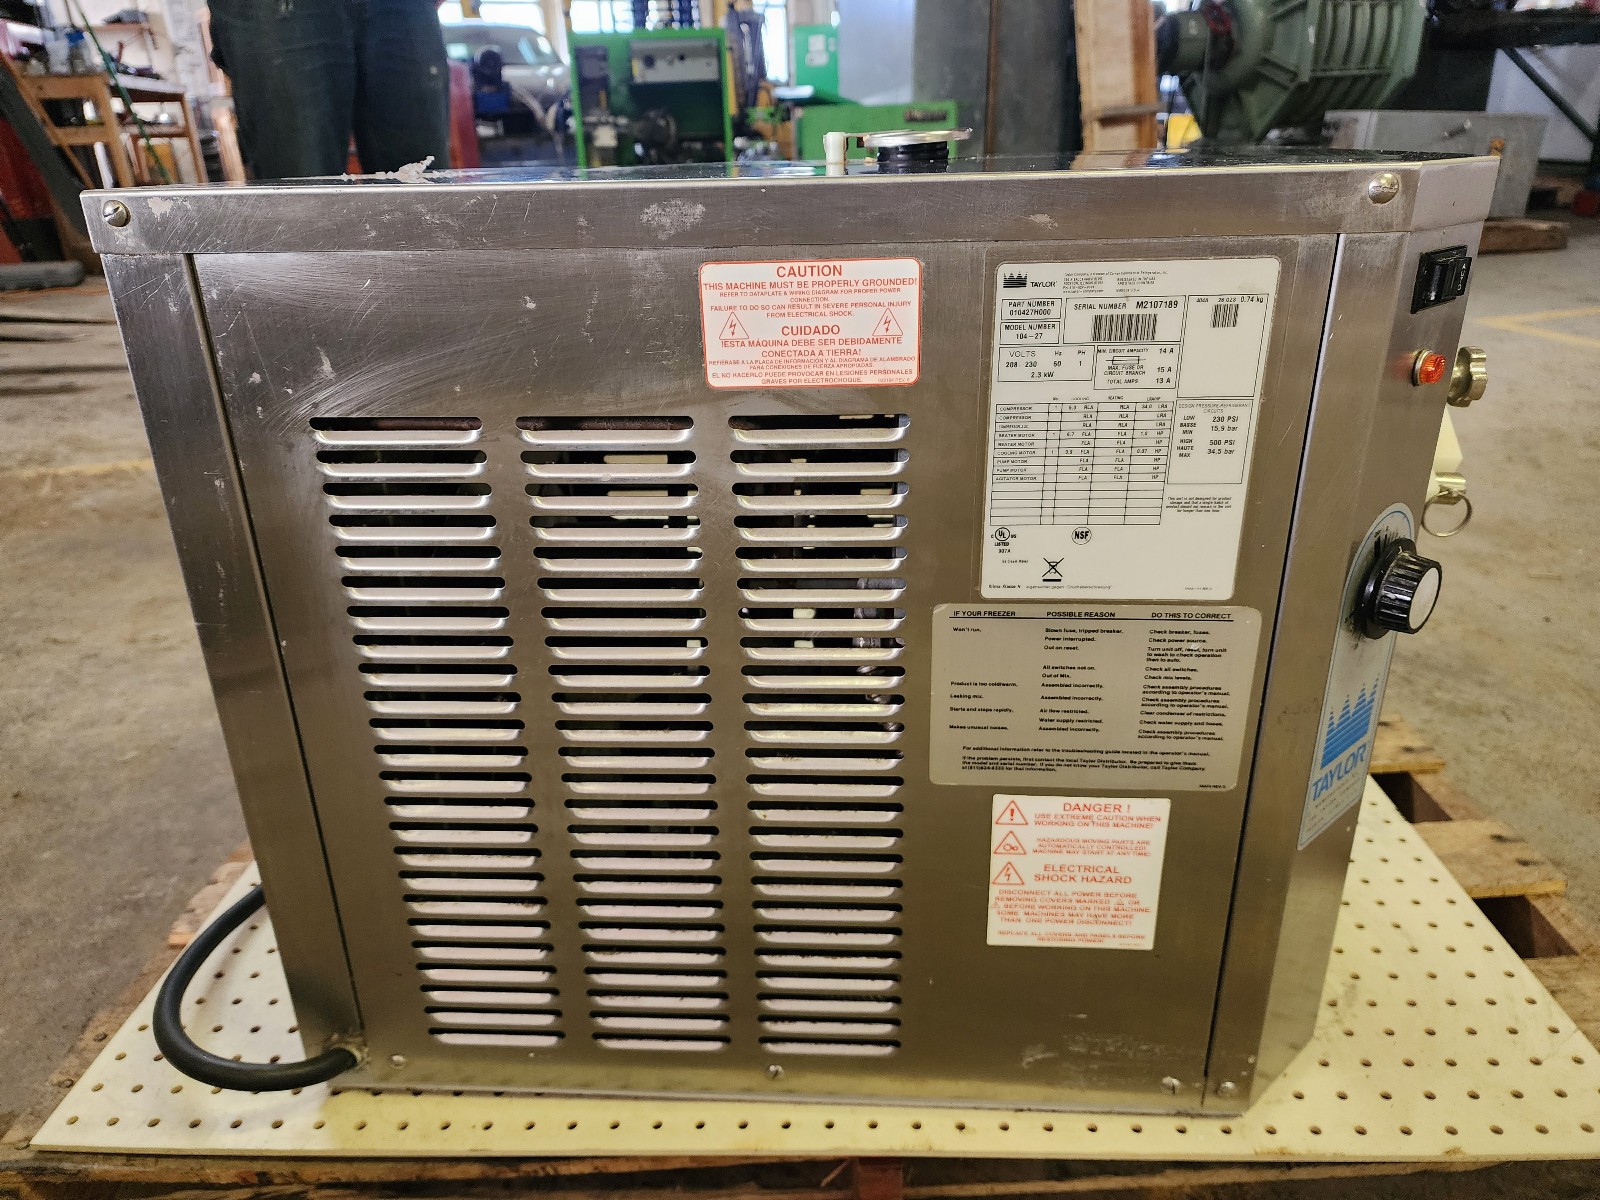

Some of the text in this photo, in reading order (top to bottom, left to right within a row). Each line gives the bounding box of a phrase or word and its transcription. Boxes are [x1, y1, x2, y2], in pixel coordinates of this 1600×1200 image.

[777, 265, 842, 278] CAUTION
[1457, 263, 1467, 291] AUTO
[703, 283, 723, 291] THIS
[726, 282, 767, 290] MACHINE
[769, 281, 794, 289] MUST
[811, 279, 860, 288] PROPERLY
[862, 277, 917, 287] GROUNDED!
[1098, 302, 1127, 310] NUMBER
[1135, 300, 1179, 309] M2107189
[1009, 308, 1052, 316] 010427H000
[781, 324, 841, 336] CUIDADO
[1028, 323, 1056, 331] NUMBER
[748, 338, 789, 347] MÁQUINA
[791, 339, 815, 347] DEBE
[817, 338, 836, 346] SER
[838, 337, 903, 346] DEBIDAMENTE
[761, 350, 816, 358] CONECTADA
[826, 349, 861, 357] TIERRA!
[1009, 350, 1036, 358] VOLTS
[1024, 360, 1038, 368] 230
[1226, 415, 1239, 423] PSI
[1074, 531, 1090, 540] NSF
[1312, 742, 1367, 801] TAYLOR
[1063, 802, 1122, 813] DANGER
[1043, 864, 1120, 874] ELECTRICAL
[1034, 873, 1133, 884] SHOCK HAZARD
